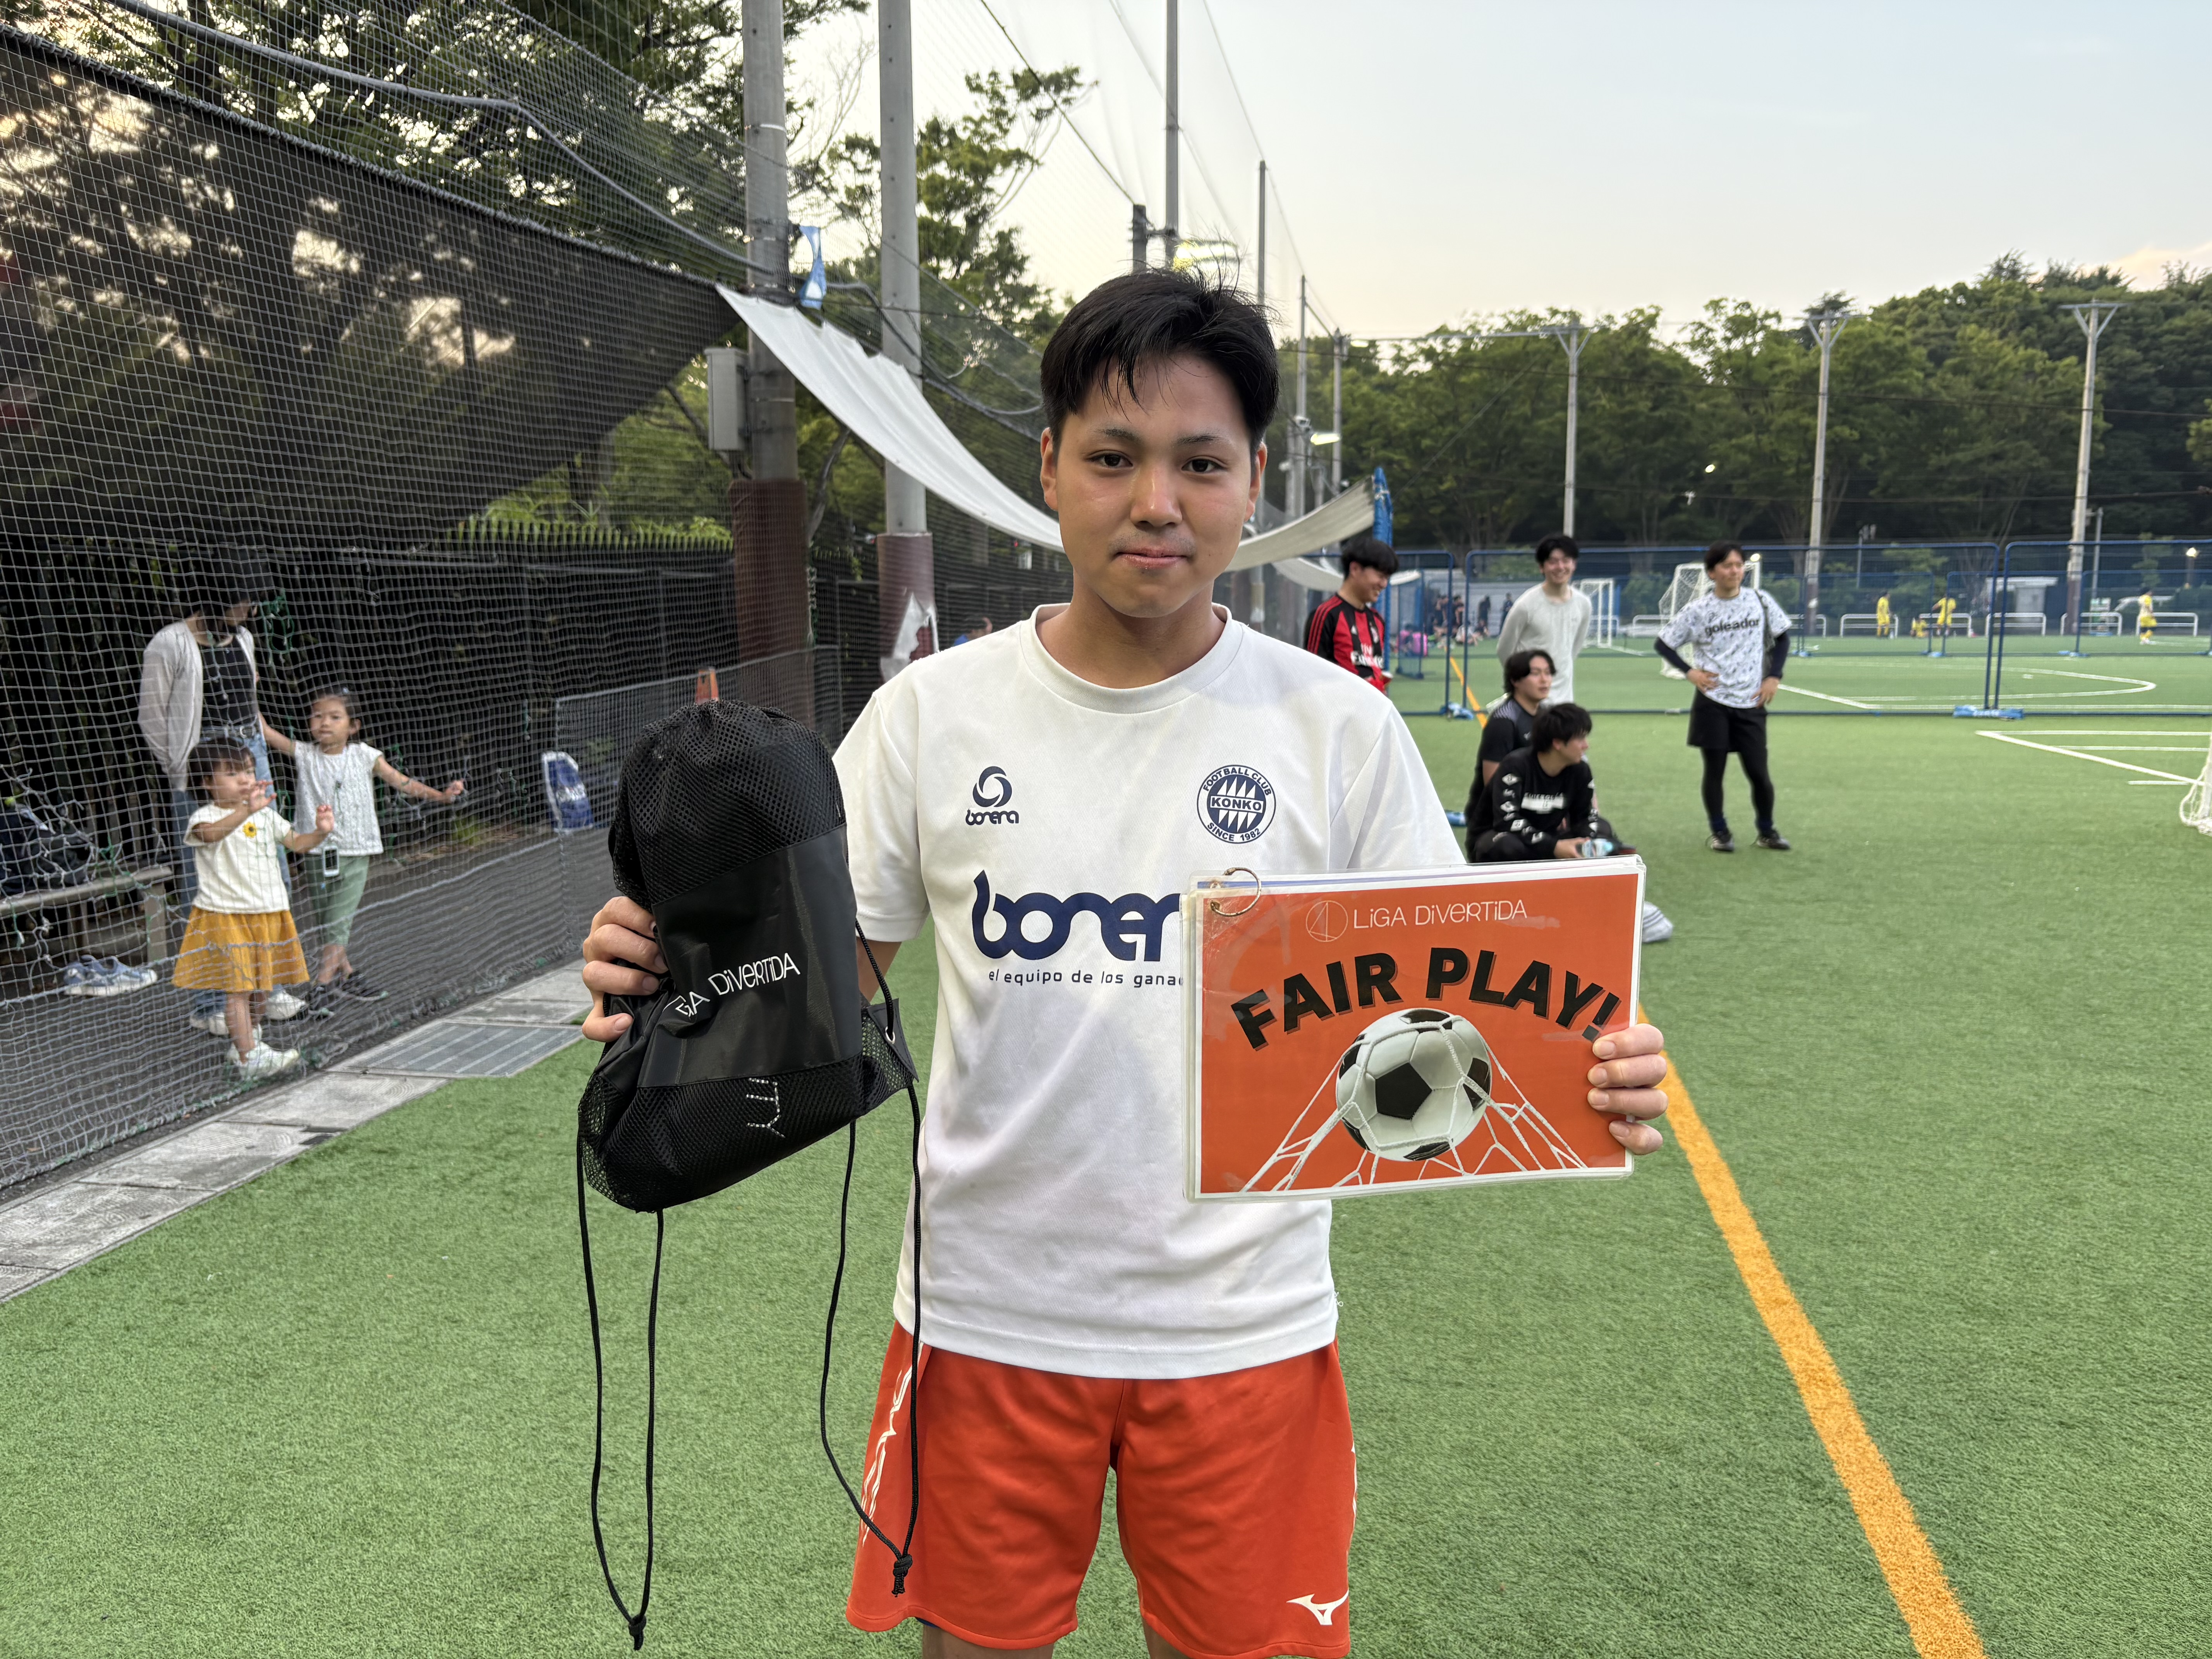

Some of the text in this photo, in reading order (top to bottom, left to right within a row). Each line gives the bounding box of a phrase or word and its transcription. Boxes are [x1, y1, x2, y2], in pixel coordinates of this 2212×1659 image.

[1705, 618, 1759, 637] goleador
[1203, 767, 1272, 795] FOOTBALL CLUB
[1211, 797, 1262, 811] KONKO
[1207, 822, 1261, 841] SINCE 1982
[972, 870, 1180, 962] boner
[989, 969, 999, 981] el
[1004, 969, 1062, 986] equipo
[1072, 970, 1093, 983] de
[1101, 971, 1123, 984] los
[1230, 947, 1621, 1051] FAIR PLAY!
